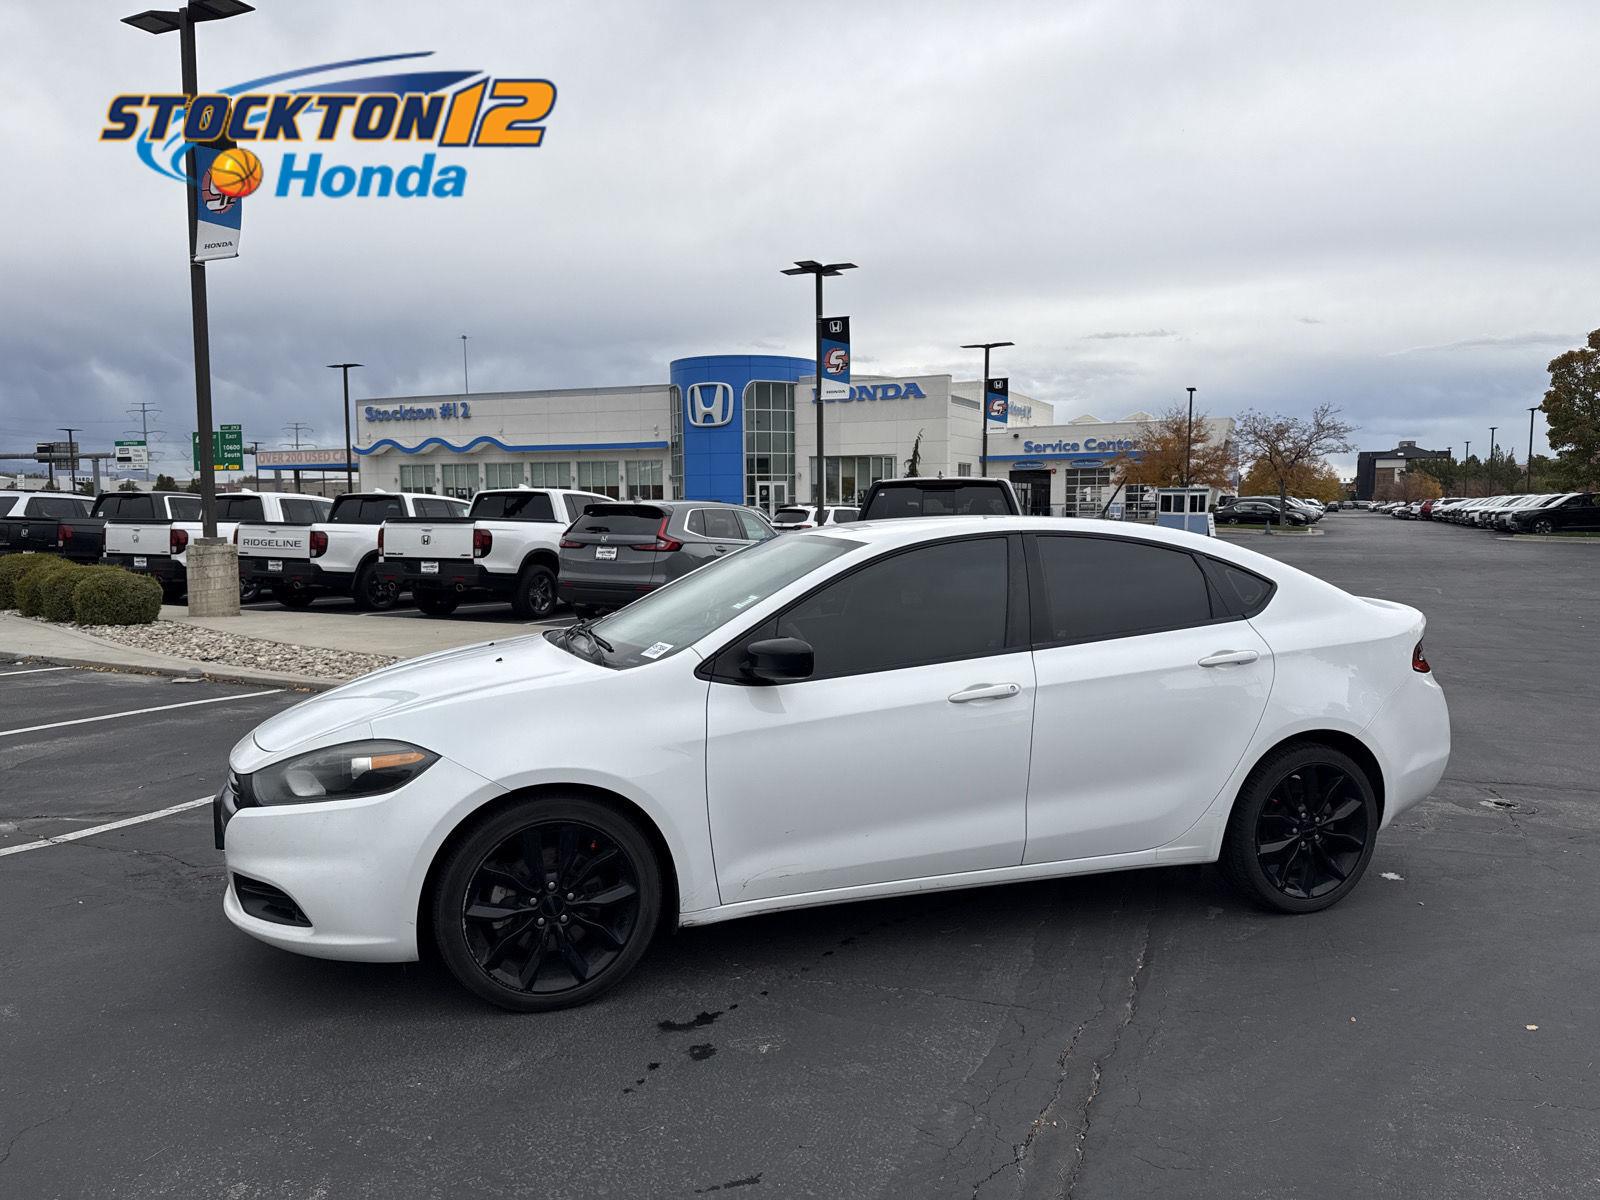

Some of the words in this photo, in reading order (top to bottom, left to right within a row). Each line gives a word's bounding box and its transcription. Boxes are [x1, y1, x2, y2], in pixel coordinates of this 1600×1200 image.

[204, 240, 234, 250] HONDA
[365, 404, 437, 422] Stockton
[440, 401, 471, 420] #12
[1023, 438, 1080, 453] Service
[259, 453, 284, 464] OVER
[284, 452, 303, 463] 200
[304, 450, 331, 462] USED
[243, 538, 303, 548] RIDGELINE
